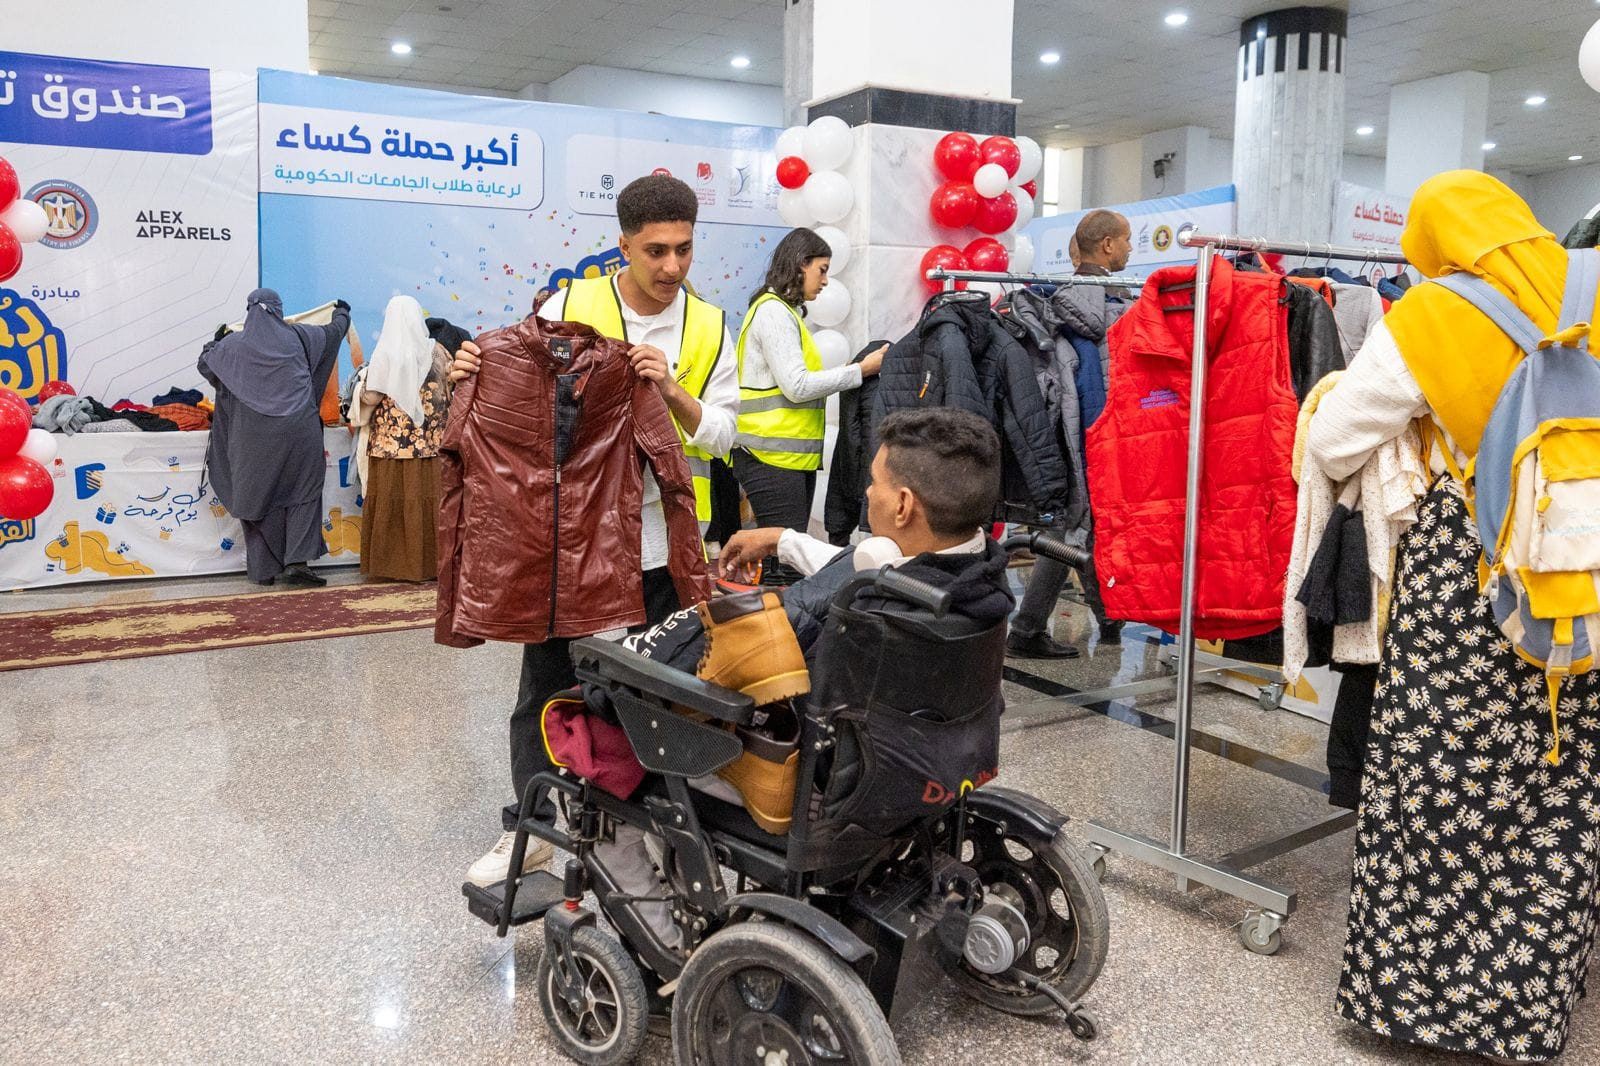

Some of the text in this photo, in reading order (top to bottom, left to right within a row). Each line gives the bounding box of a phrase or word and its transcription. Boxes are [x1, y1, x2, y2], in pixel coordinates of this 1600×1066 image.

[31, 73, 186, 122] صندوق
[276, 123, 519, 172] أكبر حملة كساء
[274, 164, 521, 198] لرعاية طلاب الجامعات الحكومية
[136, 210, 183, 224] ALEX
[136, 225, 232, 241] APPARELS
[31, 284, 80, 302] مبادرة
[123, 502, 198, 527] يوم فرحة
